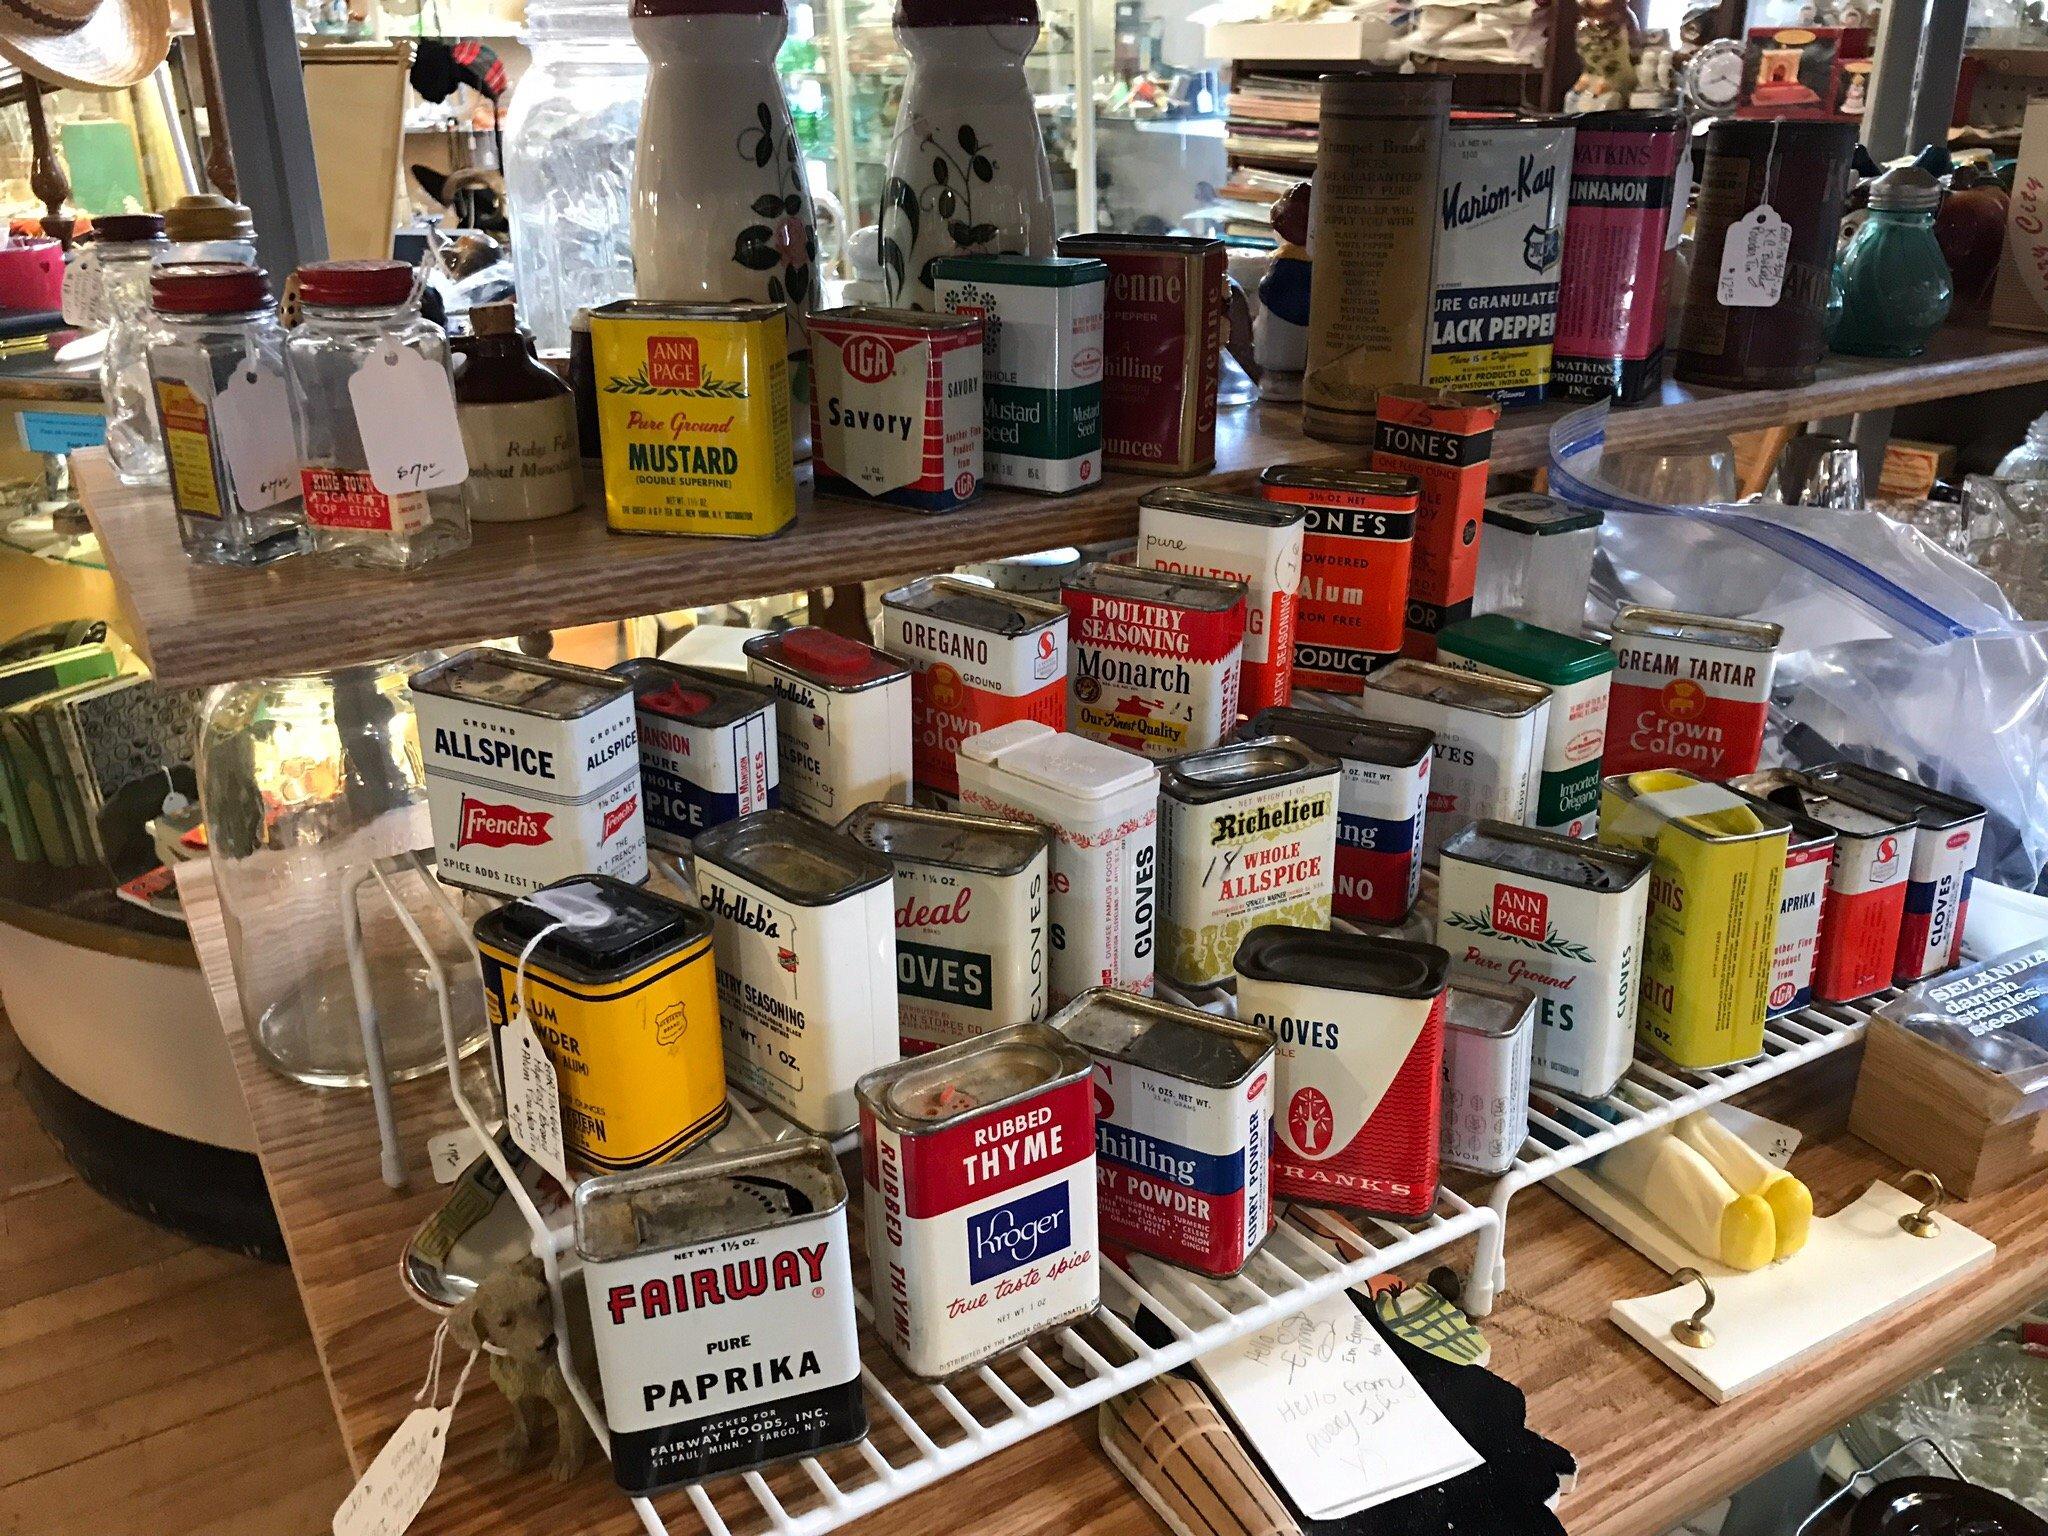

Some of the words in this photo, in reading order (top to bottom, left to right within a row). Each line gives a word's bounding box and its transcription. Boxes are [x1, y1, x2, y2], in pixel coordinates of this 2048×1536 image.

[1384, 138, 1426, 154] Brand
[1572, 181, 1648, 202] INNAMON
[1468, 290, 1558, 308] GRANULATE
[1432, 317, 1484, 345] LACK
[653, 343, 693, 360] ANN
[850, 340, 888, 377] IGA
[1556, 360, 1613, 374] WATKINS
[653, 363, 694, 382] PAGE
[1105, 356, 1164, 384] hilling
[948, 377, 978, 398] SAVORY
[627, 411, 664, 431] Pure
[670, 412, 734, 440] Ground
[828, 397, 912, 441] Savory
[1073, 401, 1100, 423] Mustard
[1077, 419, 1096, 439] Seed
[1384, 427, 1459, 460] TONE'S
[629, 443, 738, 475] MUSTARD
[315, 503, 338, 514] TOP
[1305, 509, 1387, 535] ONE'S
[1146, 535, 1188, 551] pure
[1304, 554, 1370, 570] OWDERED
[1300, 575, 1364, 606] Alum
[1091, 598, 1186, 632] POULTRY
[1276, 594, 1291, 667] SEASONING
[1332, 615, 1362, 628] FREE
[902, 620, 988, 665] OREGANO
[1082, 619, 1190, 654] SEASONING
[1077, 648, 1191, 695] Monarch
[1296, 647, 1378, 673] RODUCT
[1619, 649, 1680, 677] CREAM
[1690, 657, 1756, 688] TARTAR
[963, 673, 1002, 691] GROUND
[463, 718, 516, 736] GROUND
[590, 716, 631, 744] GROUND
[1081, 708, 1102, 725] Our
[1103, 713, 1137, 731] Finest
[1137, 719, 1182, 742] Quality
[1636, 710, 1722, 743] Crown
[435, 728, 555, 779] ALLSPICE
[587, 730, 637, 772] ALLSPICE
[643, 752, 679, 772] PURE
[1631, 734, 1725, 768] Colony
[756, 751, 765, 803] SPICES
[1363, 770, 1377, 779] NET
[1560, 770, 1600, 798] Imported
[646, 791, 703, 827] PICE
[1560, 789, 1597, 812] Oregano
[467, 808, 538, 840] French's
[1211, 799, 1325, 846] Richelieu
[1244, 842, 1301, 870] WHOLE
[443, 857, 471, 873] SPICE
[475, 865, 500, 880] ADDS
[504, 873, 528, 888] ZEST
[898, 870, 918, 881] WT.
[940, 877, 959, 887] OZ.
[1218, 856, 1322, 901] ALLSPICE
[701, 884, 780, 938] Holleb's
[896, 887, 972, 928] deal
[1134, 845, 1154, 959] CLOVES
[1500, 891, 1541, 915] ANN
[1780, 891, 1816, 915] APRIKA
[1931, 874, 1952, 947] CLOVES
[1497, 909, 1540, 935] PAGE
[1030, 873, 1041, 1023] CLOVES
[1773, 953, 1802, 969] Product
[900, 951, 983, 997] OVES
[1463, 945, 1502, 970] Pure
[1507, 959, 1577, 990] Ground
[1617, 945, 1632, 1019] CLOVES
[1929, 949, 2048, 1002] SELANDIA
[744, 983, 805, 1030] SEASONING
[1771, 982, 1794, 1006] IGA
[1945, 980, 2021, 1014] danish
[1253, 1013, 1339, 1050] CLOVES
[1654, 1027, 1673, 1046] OZ.
[1968, 1008, 2026, 1037] steel
[740, 1026, 761, 1050] WT.
[767, 1044, 772, 1056] 1
[779, 1050, 801, 1072] OZ.
[1178, 1092, 1193, 1103] NET
[1196, 1097, 1212, 1109] WT.
[974, 1106, 1052, 1147] RUBBED
[963, 1125, 1063, 1186] THYME
[1249, 1109, 1259, 1188] POWDER
[880, 1140, 904, 1247] RUBBED
[1274, 1164, 1412, 1197] RANK'S
[1127, 1175, 1210, 1221] POWDER
[1138, 1217, 1166, 1232] CLOVES
[1182, 1233, 1210, 1247] ONION
[1144, 1211, 1171, 1226] LEAVES
[1182, 1225, 1210, 1239] CELERY
[1173, 1215, 1210, 1233] TURMERIC
[1247, 1193, 1258, 1248] CURRY
[674, 1250, 695, 1261] NET
[698, 1246, 719, 1257] WT.
[743, 1238, 760, 1247] OZ.
[1144, 1225, 1161, 1237] PEEL
[1181, 1239, 1210, 1255] GINGER
[607, 1241, 830, 1325] FAIRWAY
[946, 1290, 987, 1319] true
[994, 1268, 1041, 1299] taste
[1045, 1250, 1092, 1282] spice
[889, 1260, 911, 1351] THYME
[706, 1334, 752, 1355] PURE
[643, 1350, 822, 1412] PAPRIKA
[701, 1416, 748, 1433] PACKED
[754, 1410, 777, 1423] FOR
[1277, 1391, 1337, 1423] Hello
[650, 1433, 721, 1457] FAIRWAY
[730, 1419, 788, 1439] FOODS,
[796, 1408, 829, 1423] INC.
[652, 1458, 669, 1468] ST.
[671, 1452, 704, 1466] PAUL,
[709, 1442, 744, 1456] MINN.
[760, 1429, 800, 1444] FARGO,
